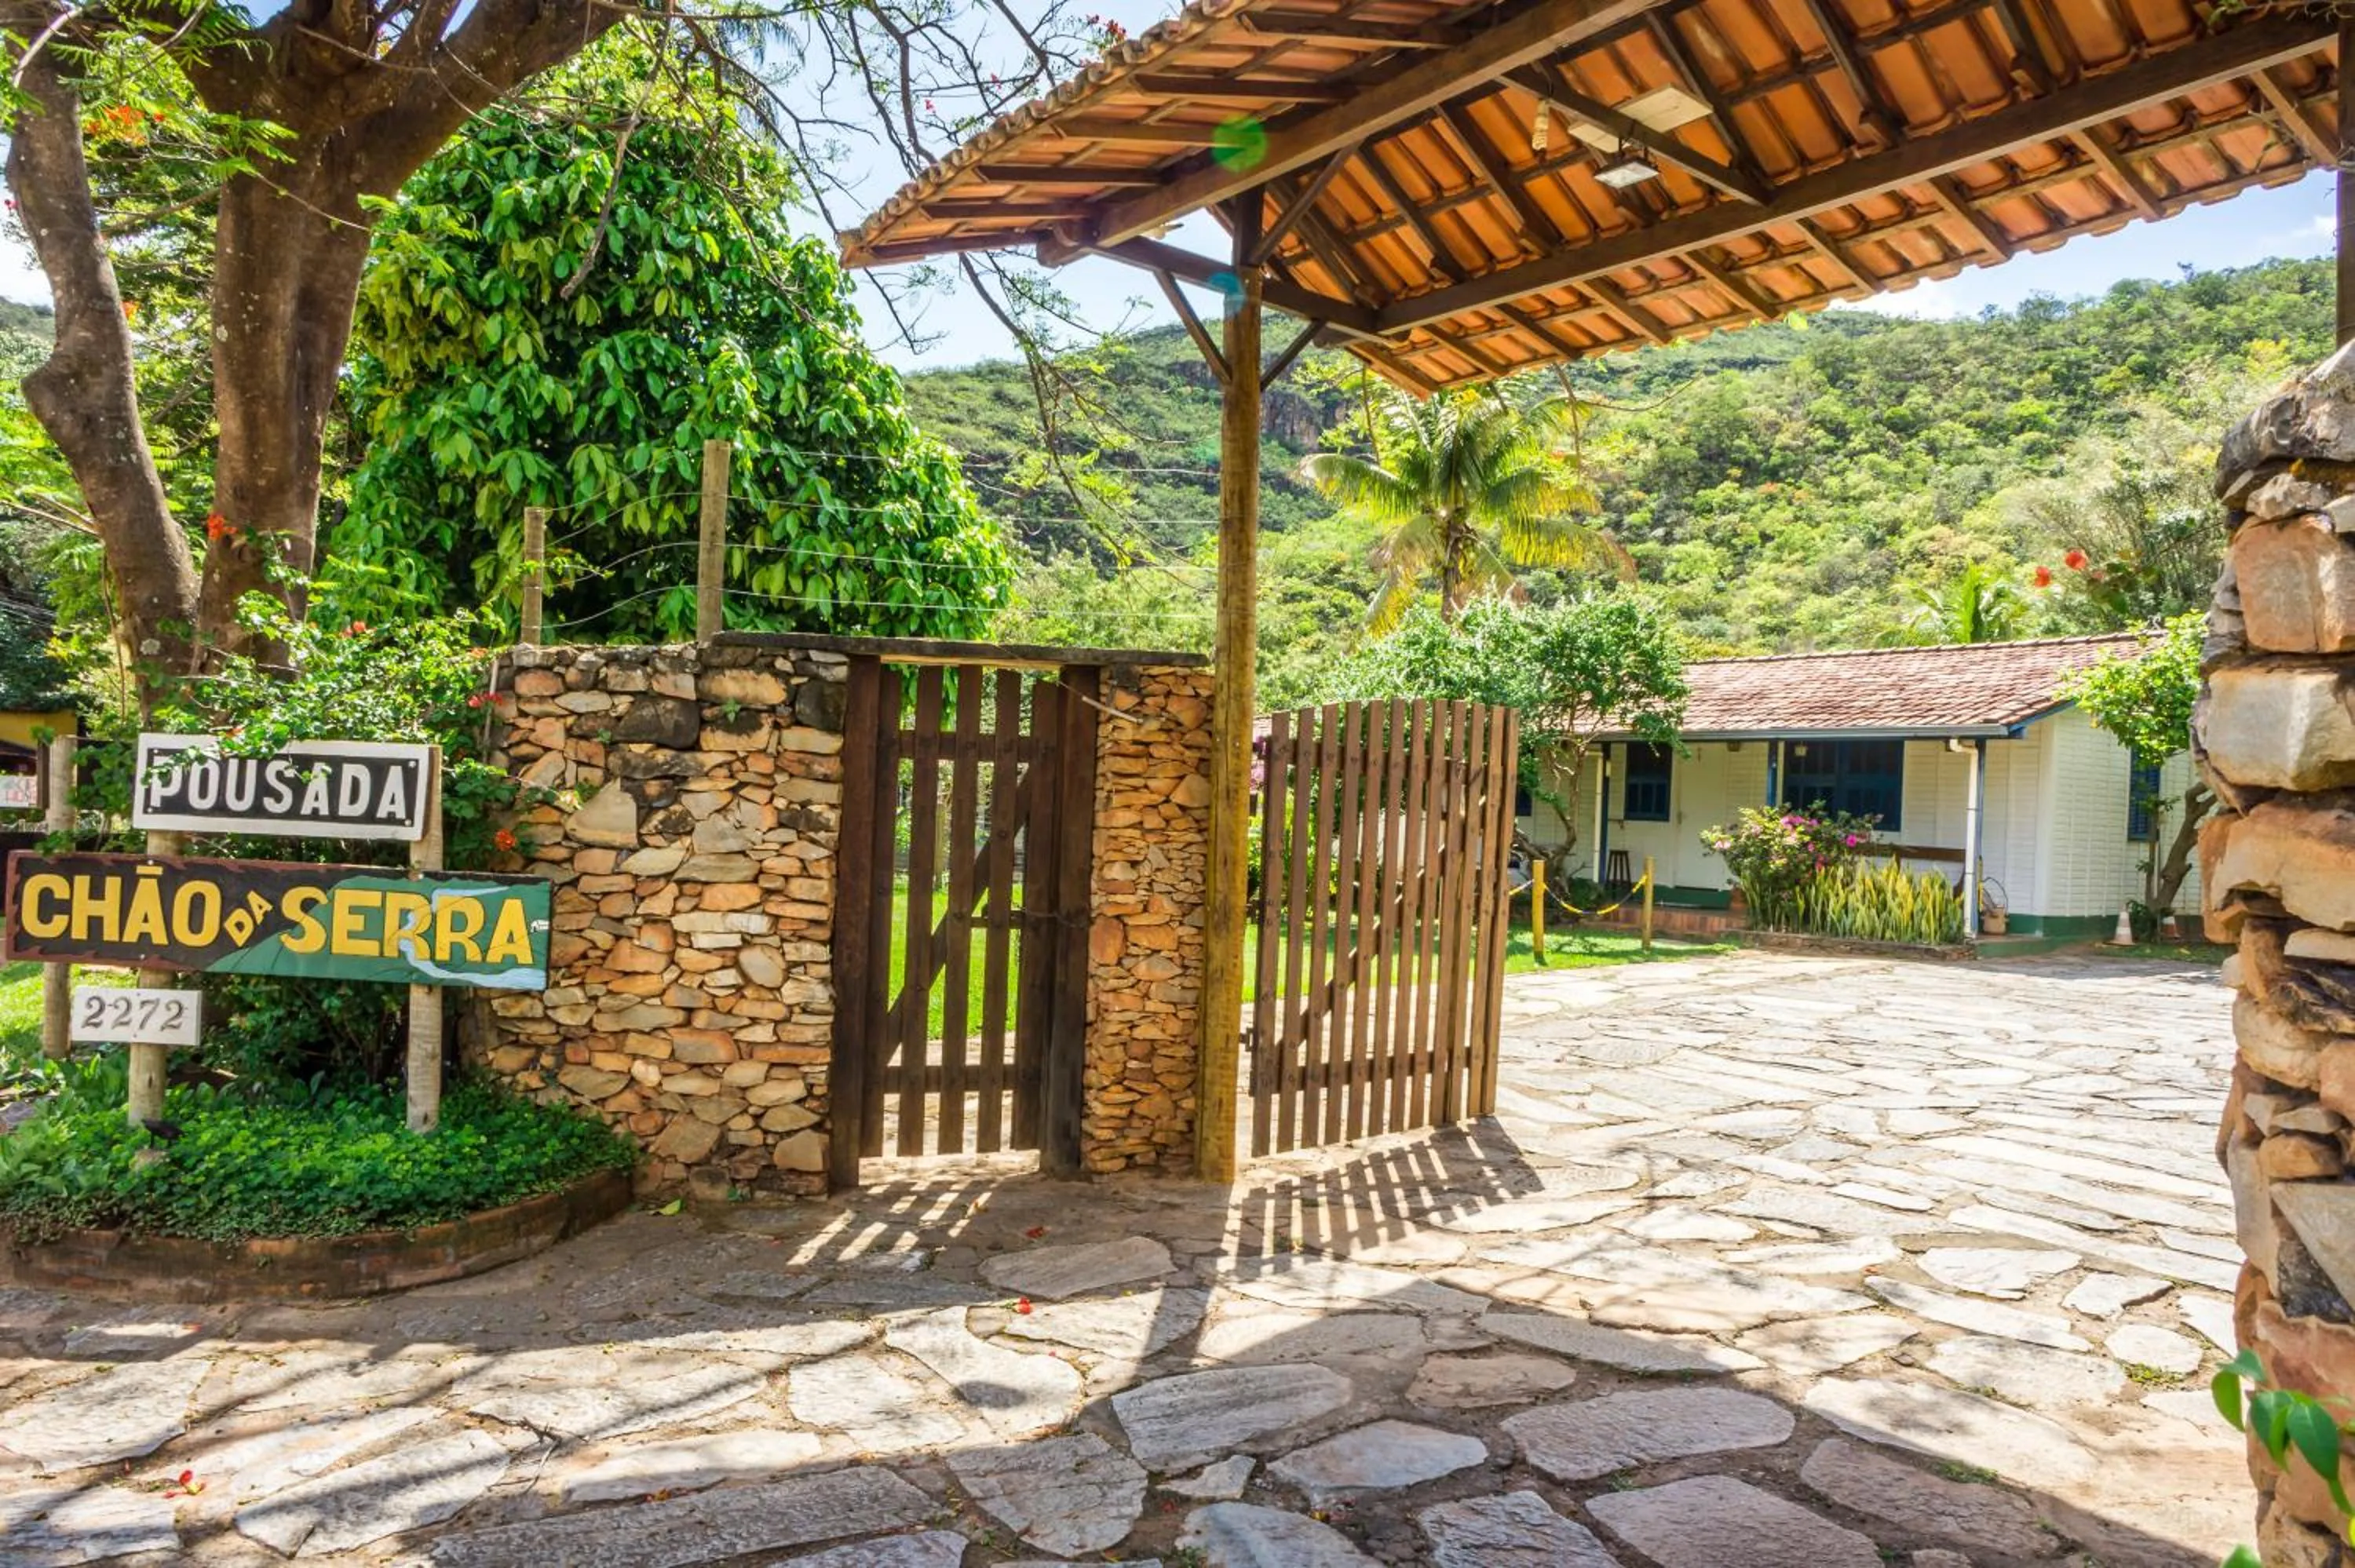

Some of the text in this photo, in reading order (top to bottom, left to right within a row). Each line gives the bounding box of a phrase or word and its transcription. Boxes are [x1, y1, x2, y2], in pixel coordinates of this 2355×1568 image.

[150, 756, 406, 819] POUSADA
[21, 866, 534, 965] CHÃO DA SERRA
[81, 995, 186, 1031] 2272
